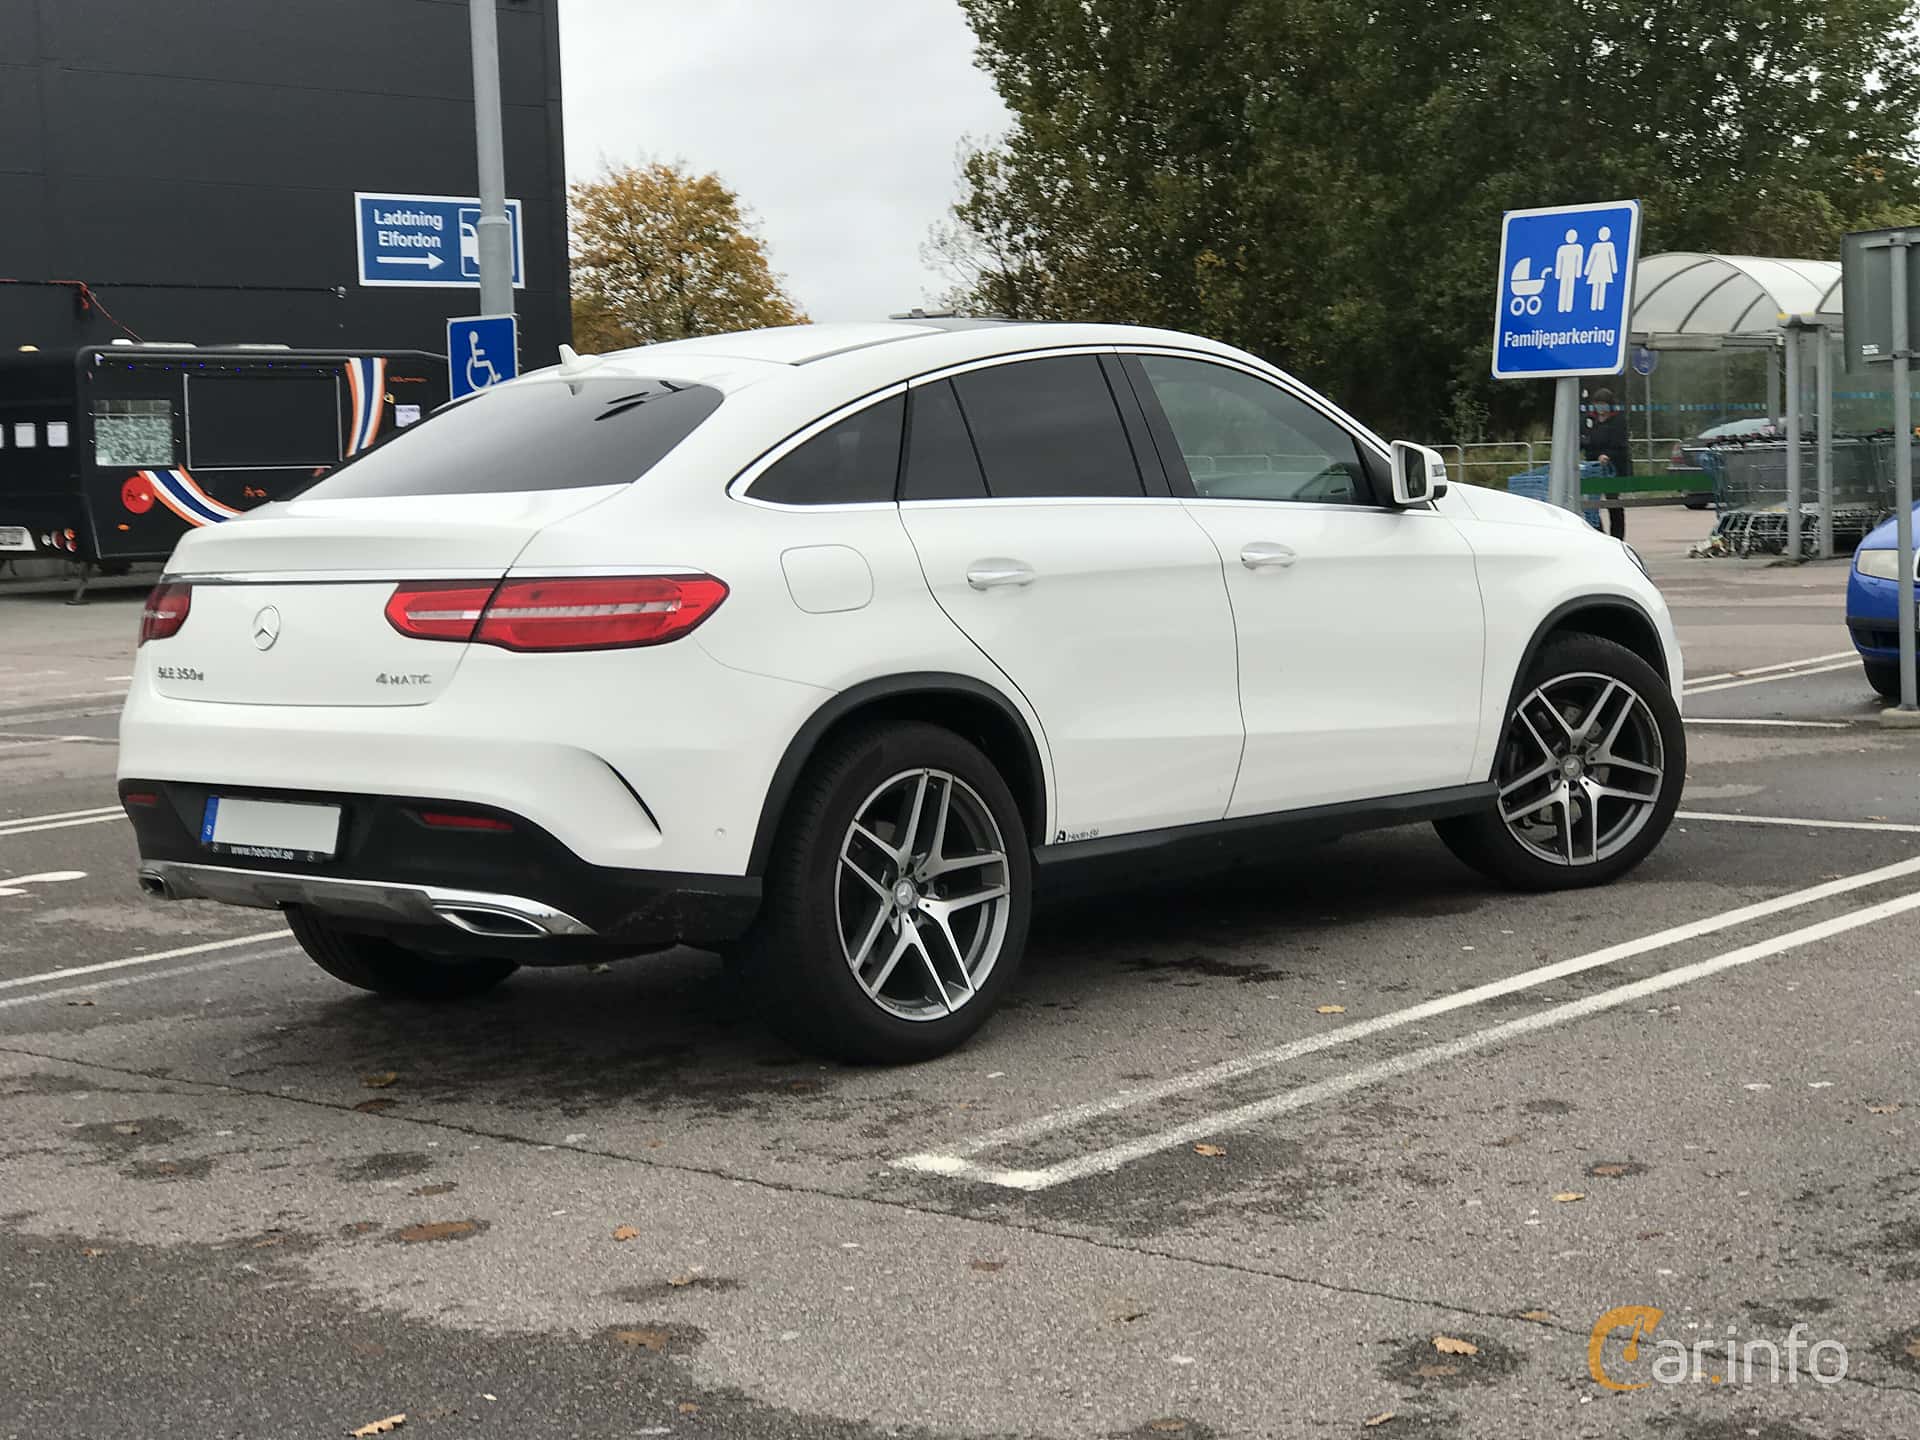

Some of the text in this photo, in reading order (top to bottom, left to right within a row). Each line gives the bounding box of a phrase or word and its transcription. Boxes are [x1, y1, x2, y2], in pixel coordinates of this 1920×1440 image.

[374, 208, 443, 231] Laddning
[378, 230, 441, 248] Elfordon
[1504, 326, 1616, 349] Familjeparkering
